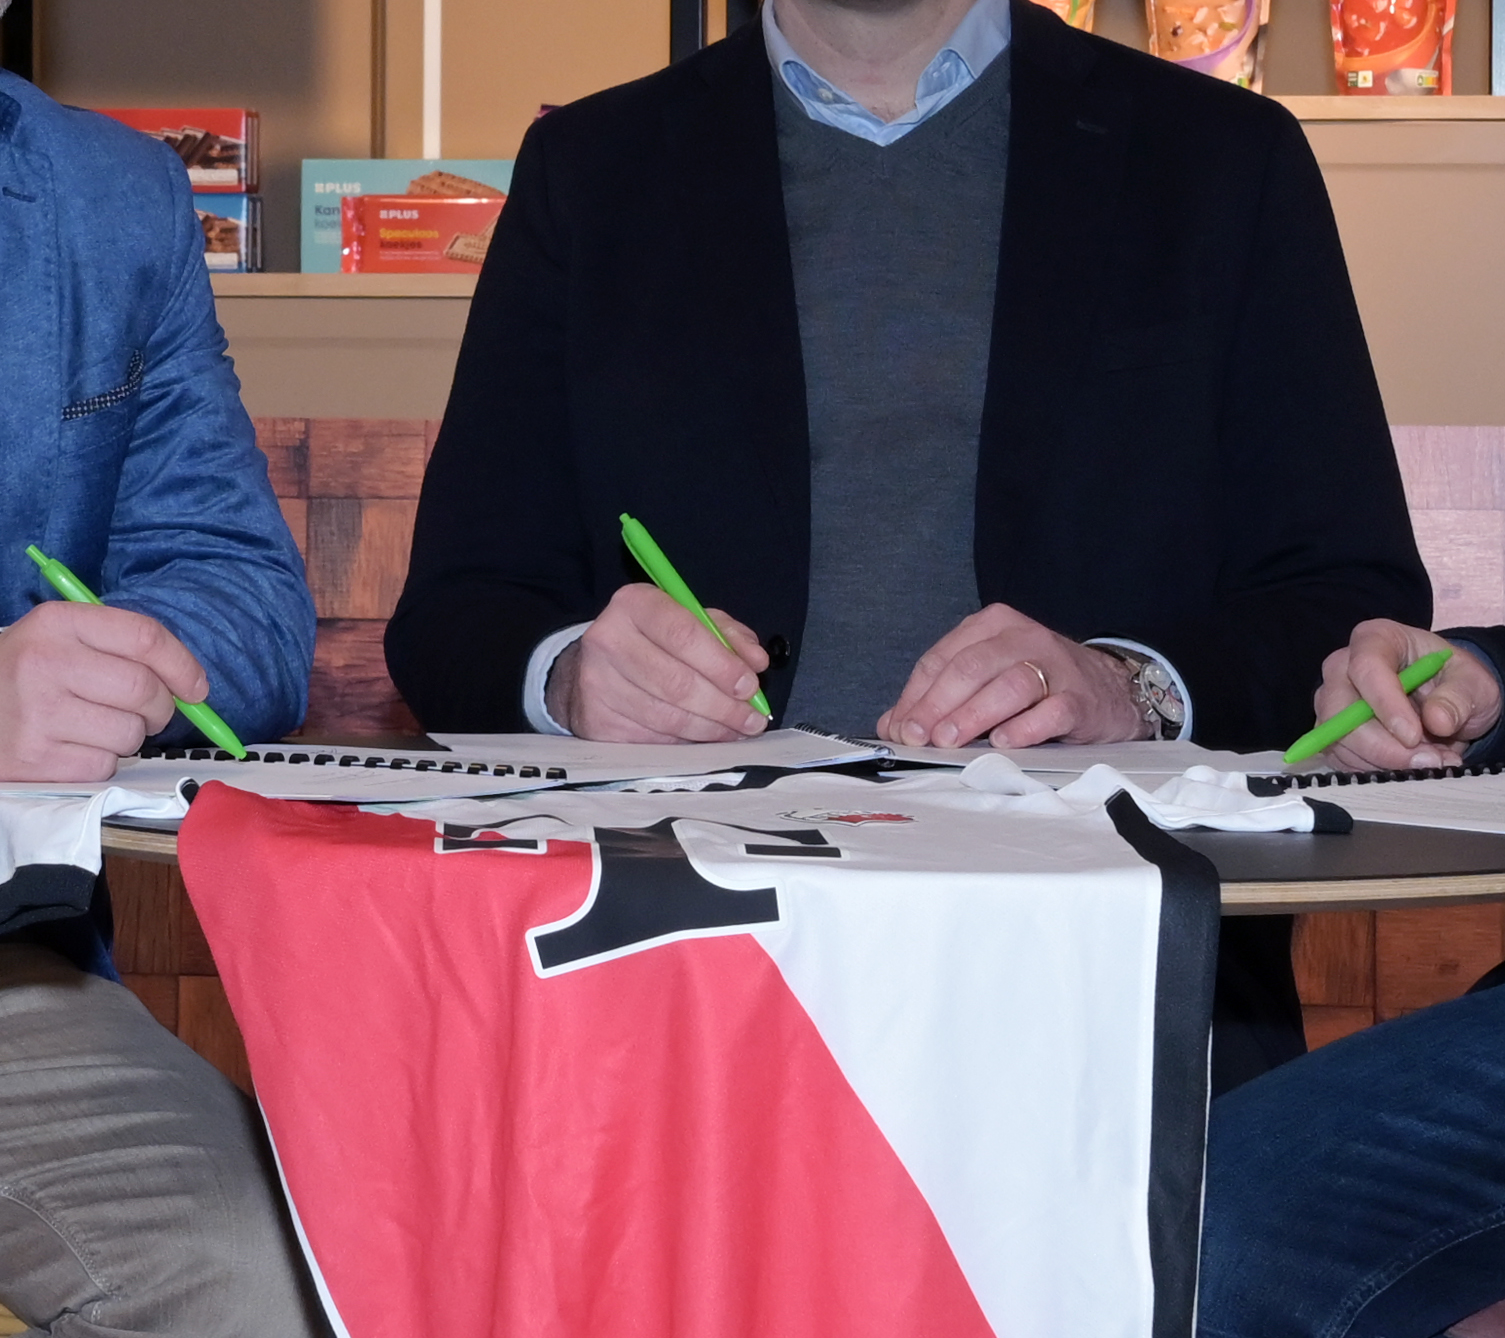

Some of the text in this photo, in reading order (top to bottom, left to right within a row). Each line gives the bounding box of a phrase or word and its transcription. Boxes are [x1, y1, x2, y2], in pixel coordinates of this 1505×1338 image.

[326, 183, 361, 193] PLUS
[315, 205, 340, 215] Kan
[389, 210, 419, 219] PLUS
